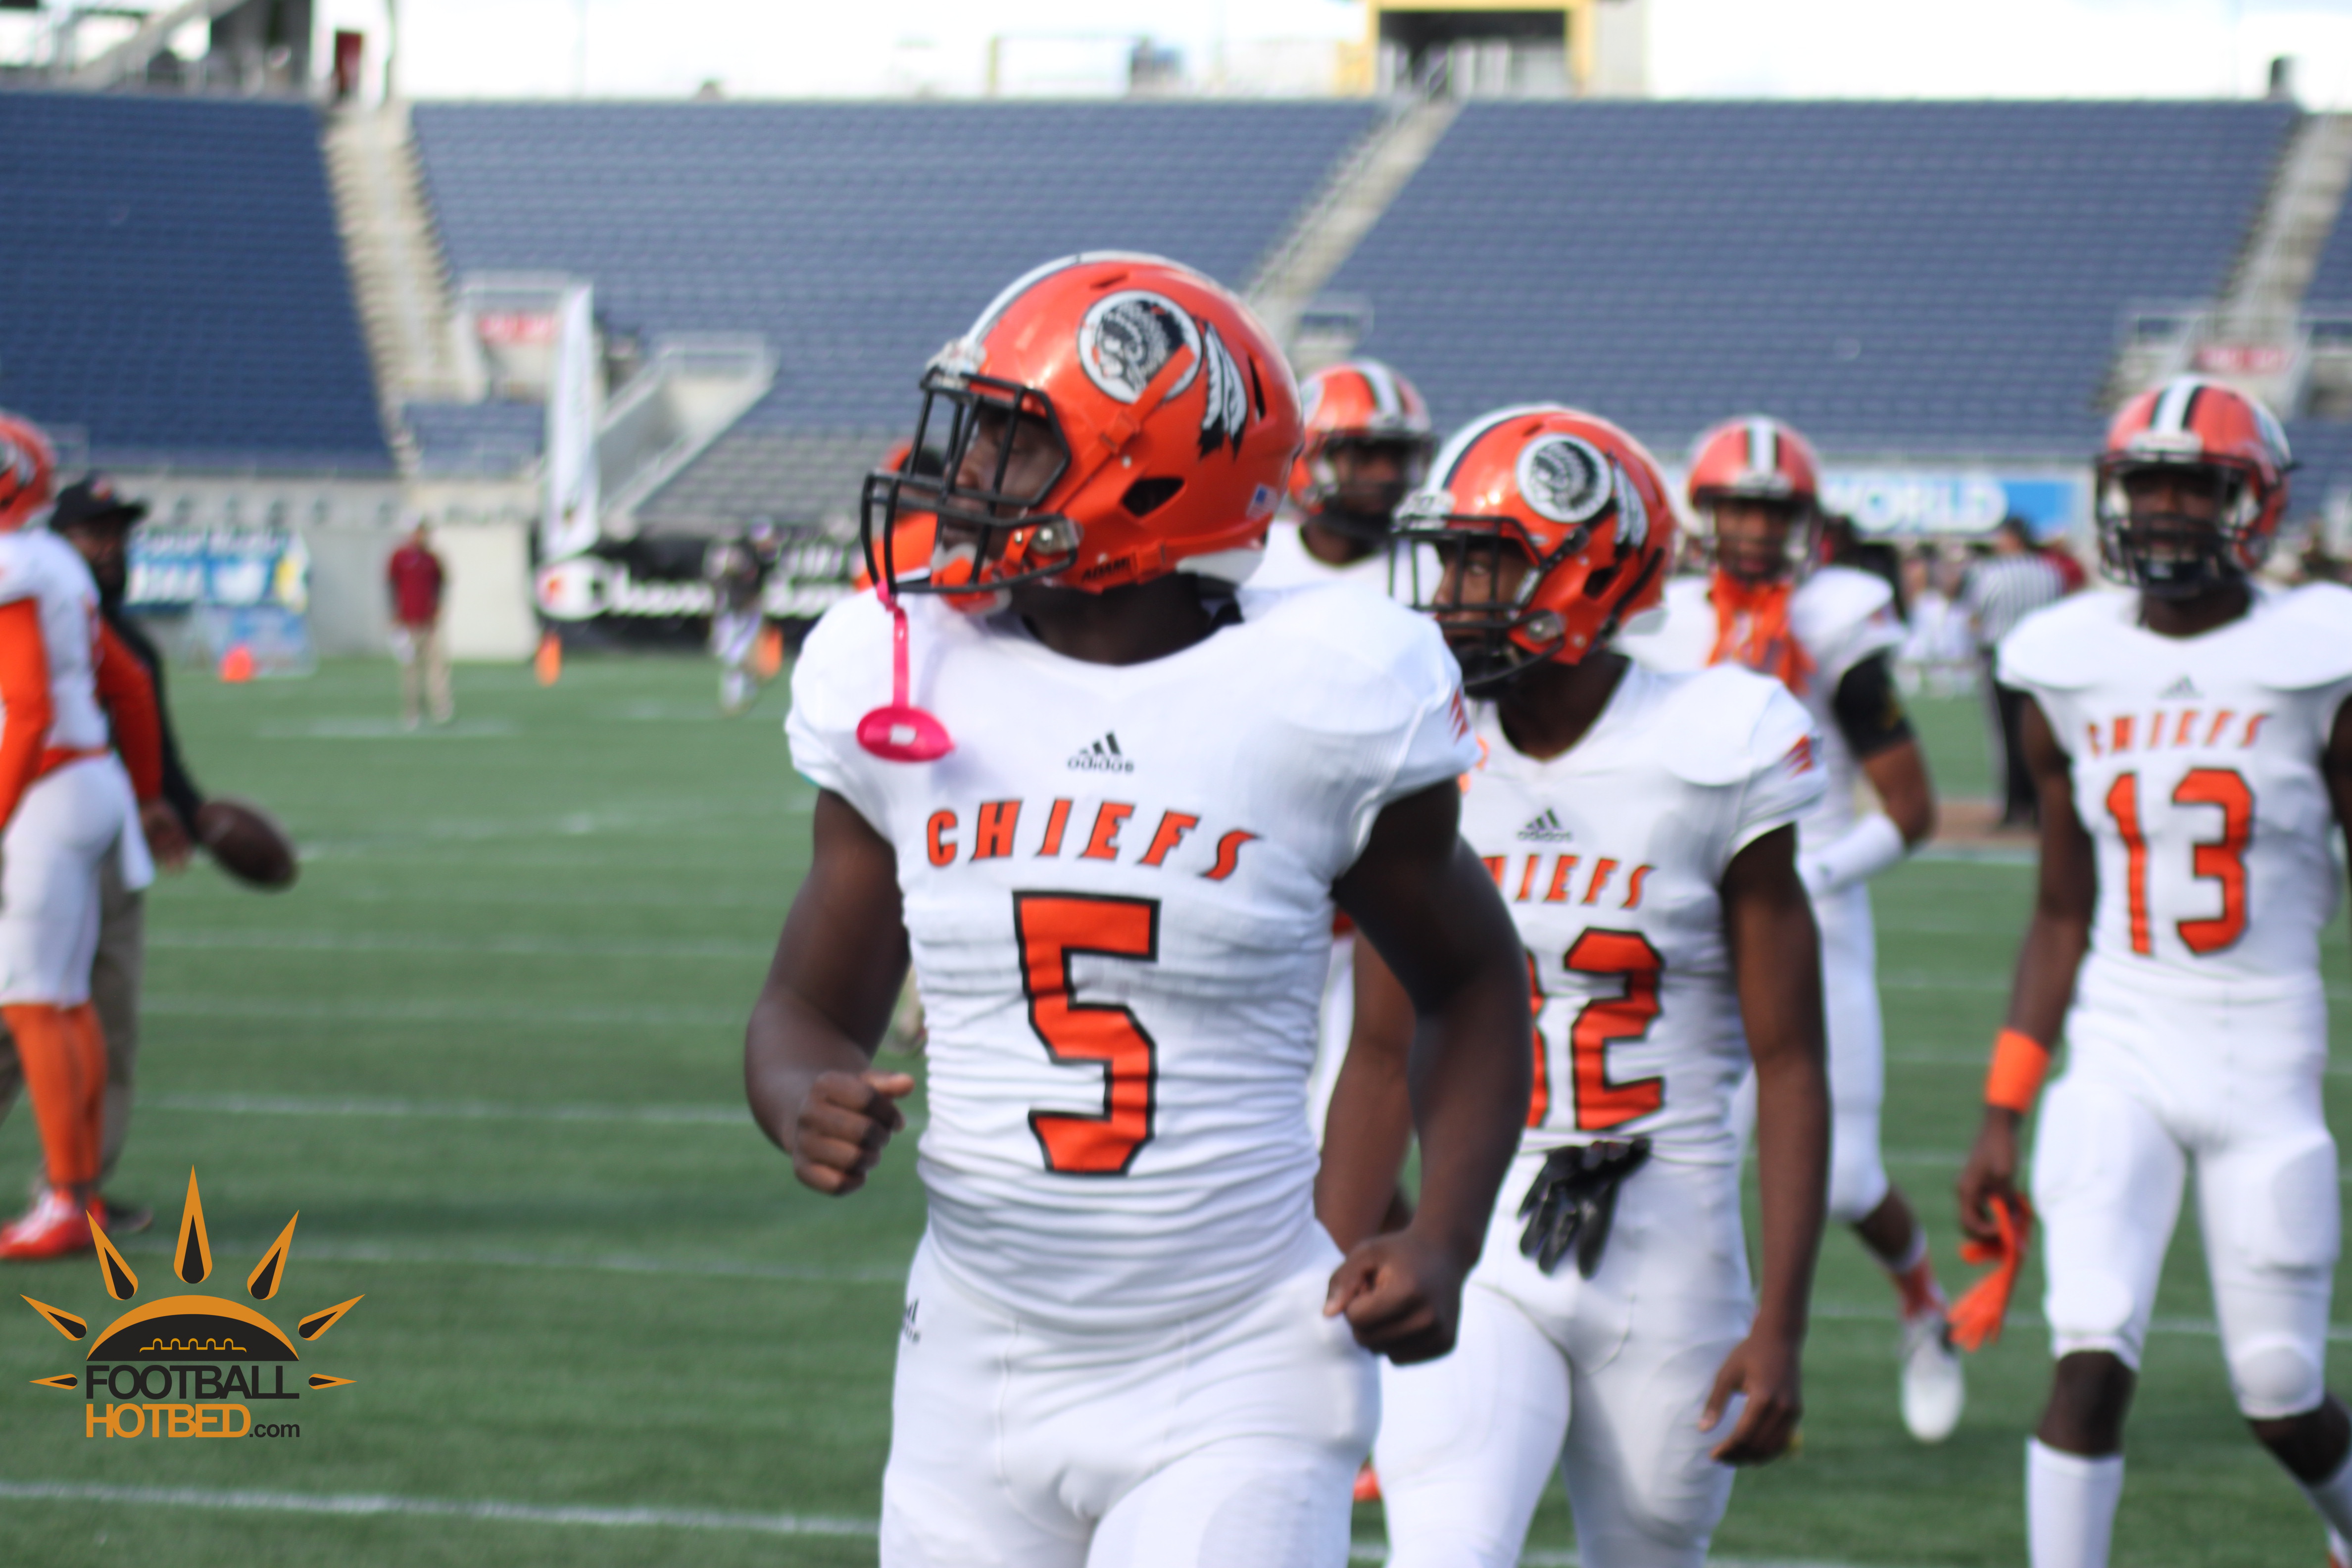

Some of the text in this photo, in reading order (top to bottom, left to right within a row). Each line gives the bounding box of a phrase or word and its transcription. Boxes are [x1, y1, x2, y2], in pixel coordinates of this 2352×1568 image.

[2084, 710, 2273, 757] CHIEFS
[927, 798, 1263, 882] CHIEFS
[2105, 767, 2254, 957] 13
[1012, 889, 1161, 1176] 5
